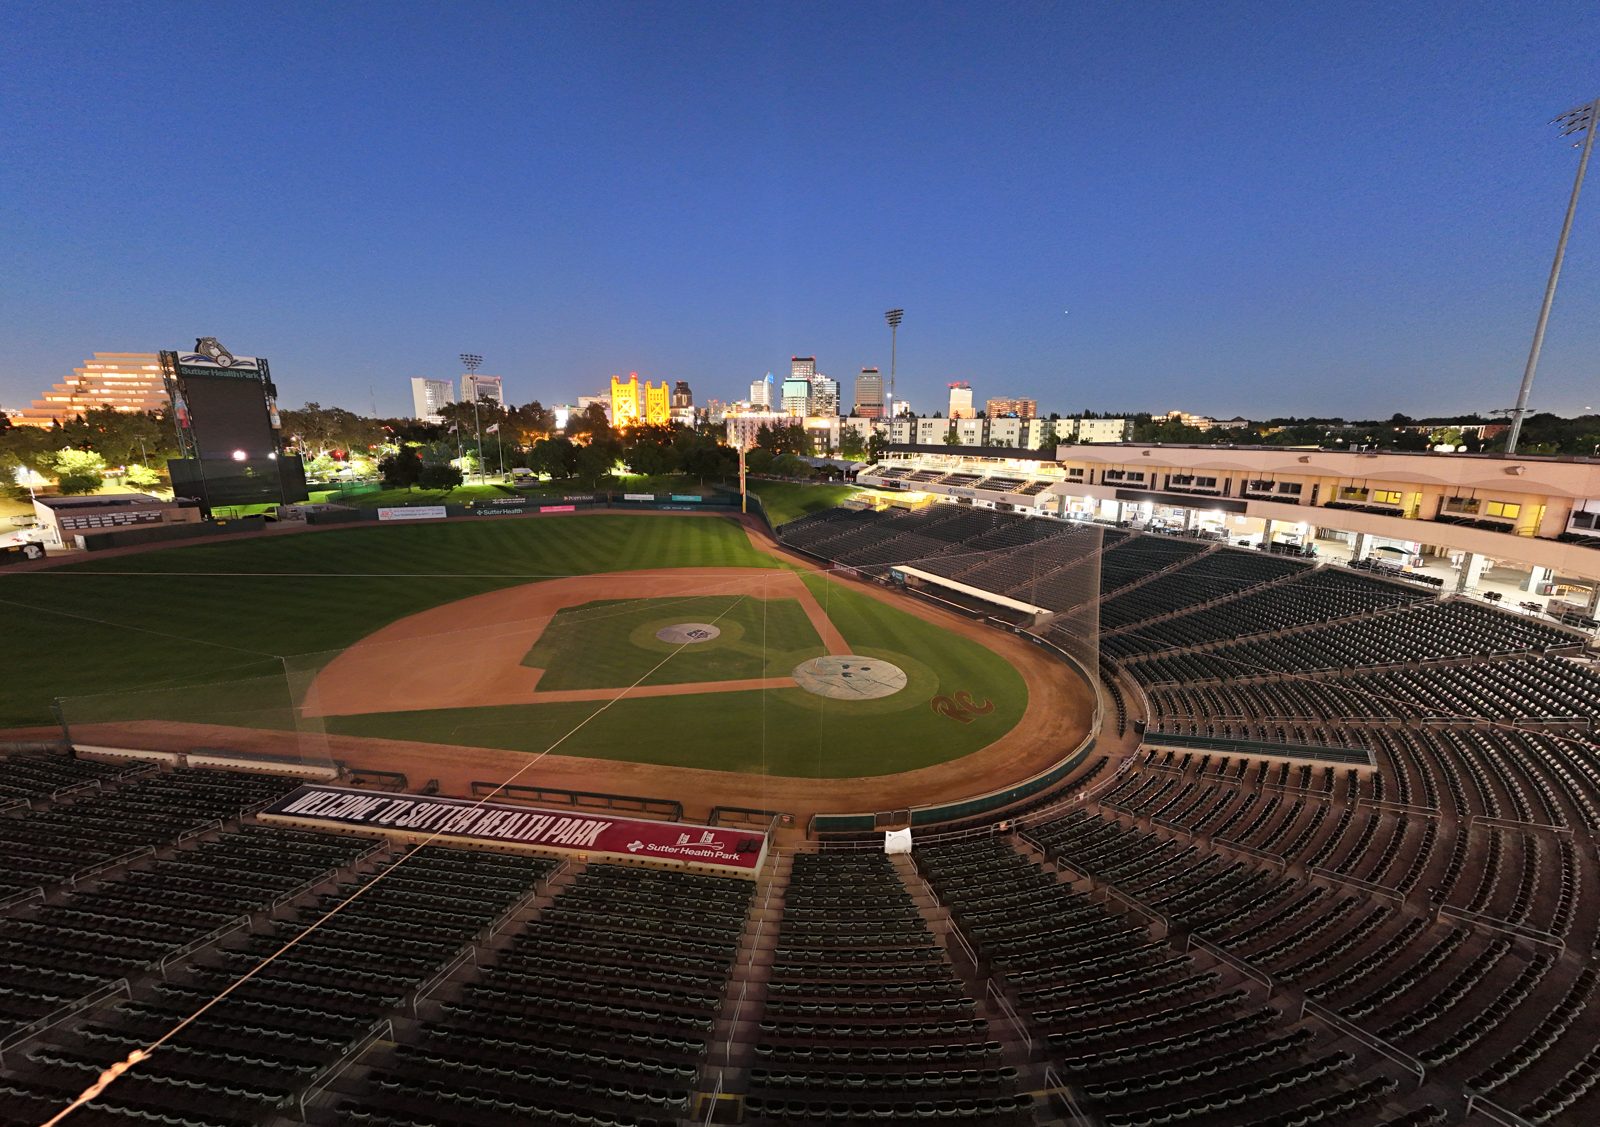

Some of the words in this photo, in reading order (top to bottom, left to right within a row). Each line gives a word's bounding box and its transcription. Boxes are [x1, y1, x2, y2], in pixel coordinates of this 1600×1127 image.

[181, 367, 210, 375] Sutter
[211, 369, 239, 378] Health
[240, 371, 259, 379] Park
[281, 791, 390, 820] WELCOME
[369, 799, 415, 824] TO
[395, 802, 485, 833] SUTTER
[467, 809, 556, 842] HEALTH
[540, 817, 613, 847] PARK
[646, 843, 680, 854] Sutter
[680, 847, 714, 858] Health
[715, 852, 741, 861] Park
